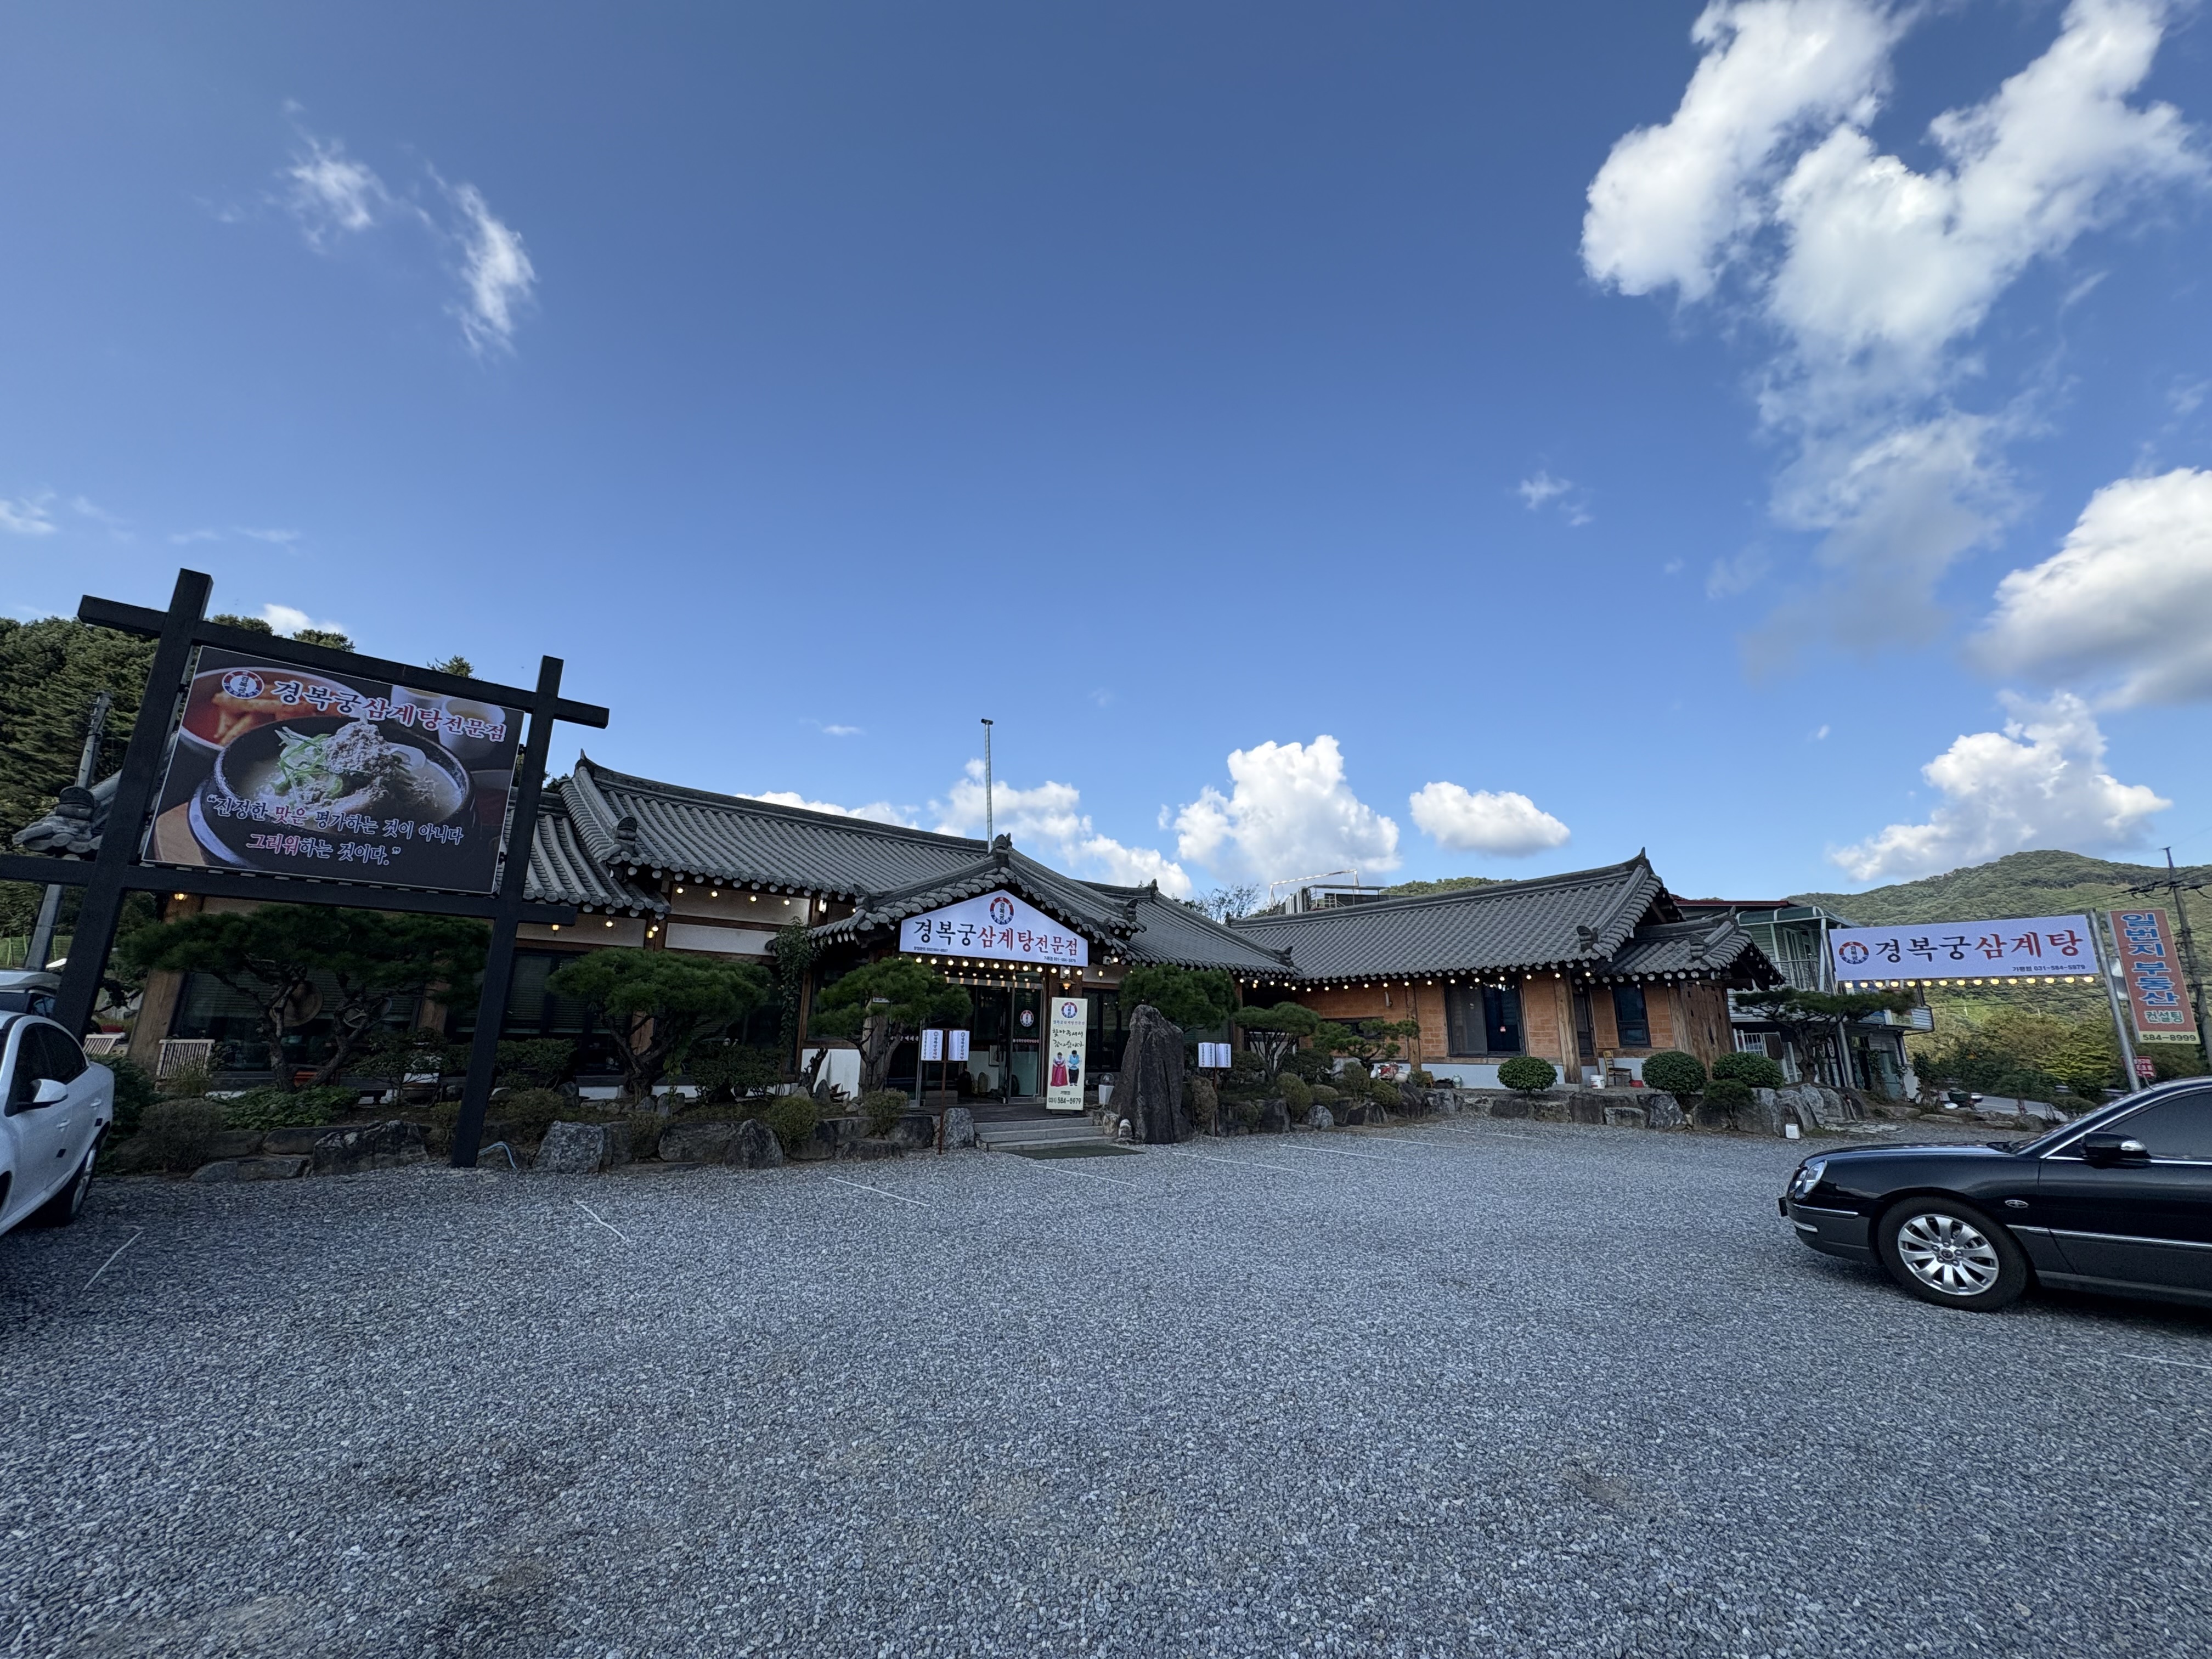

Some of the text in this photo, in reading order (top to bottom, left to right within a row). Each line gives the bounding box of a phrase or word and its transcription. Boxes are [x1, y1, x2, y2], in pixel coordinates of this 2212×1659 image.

[273, 805, 308, 826] 맛은
[314, 810, 379, 835] 평가하는
[382, 819, 414, 839] 것이
[419, 823, 464, 845] 아니다
[246, 833, 334, 859] 그리워하는
[2120, 912, 2166, 957] 일번지
[2131, 961, 2180, 1007] 부동산
[2144, 1010, 2185, 1024] 컨설팅
